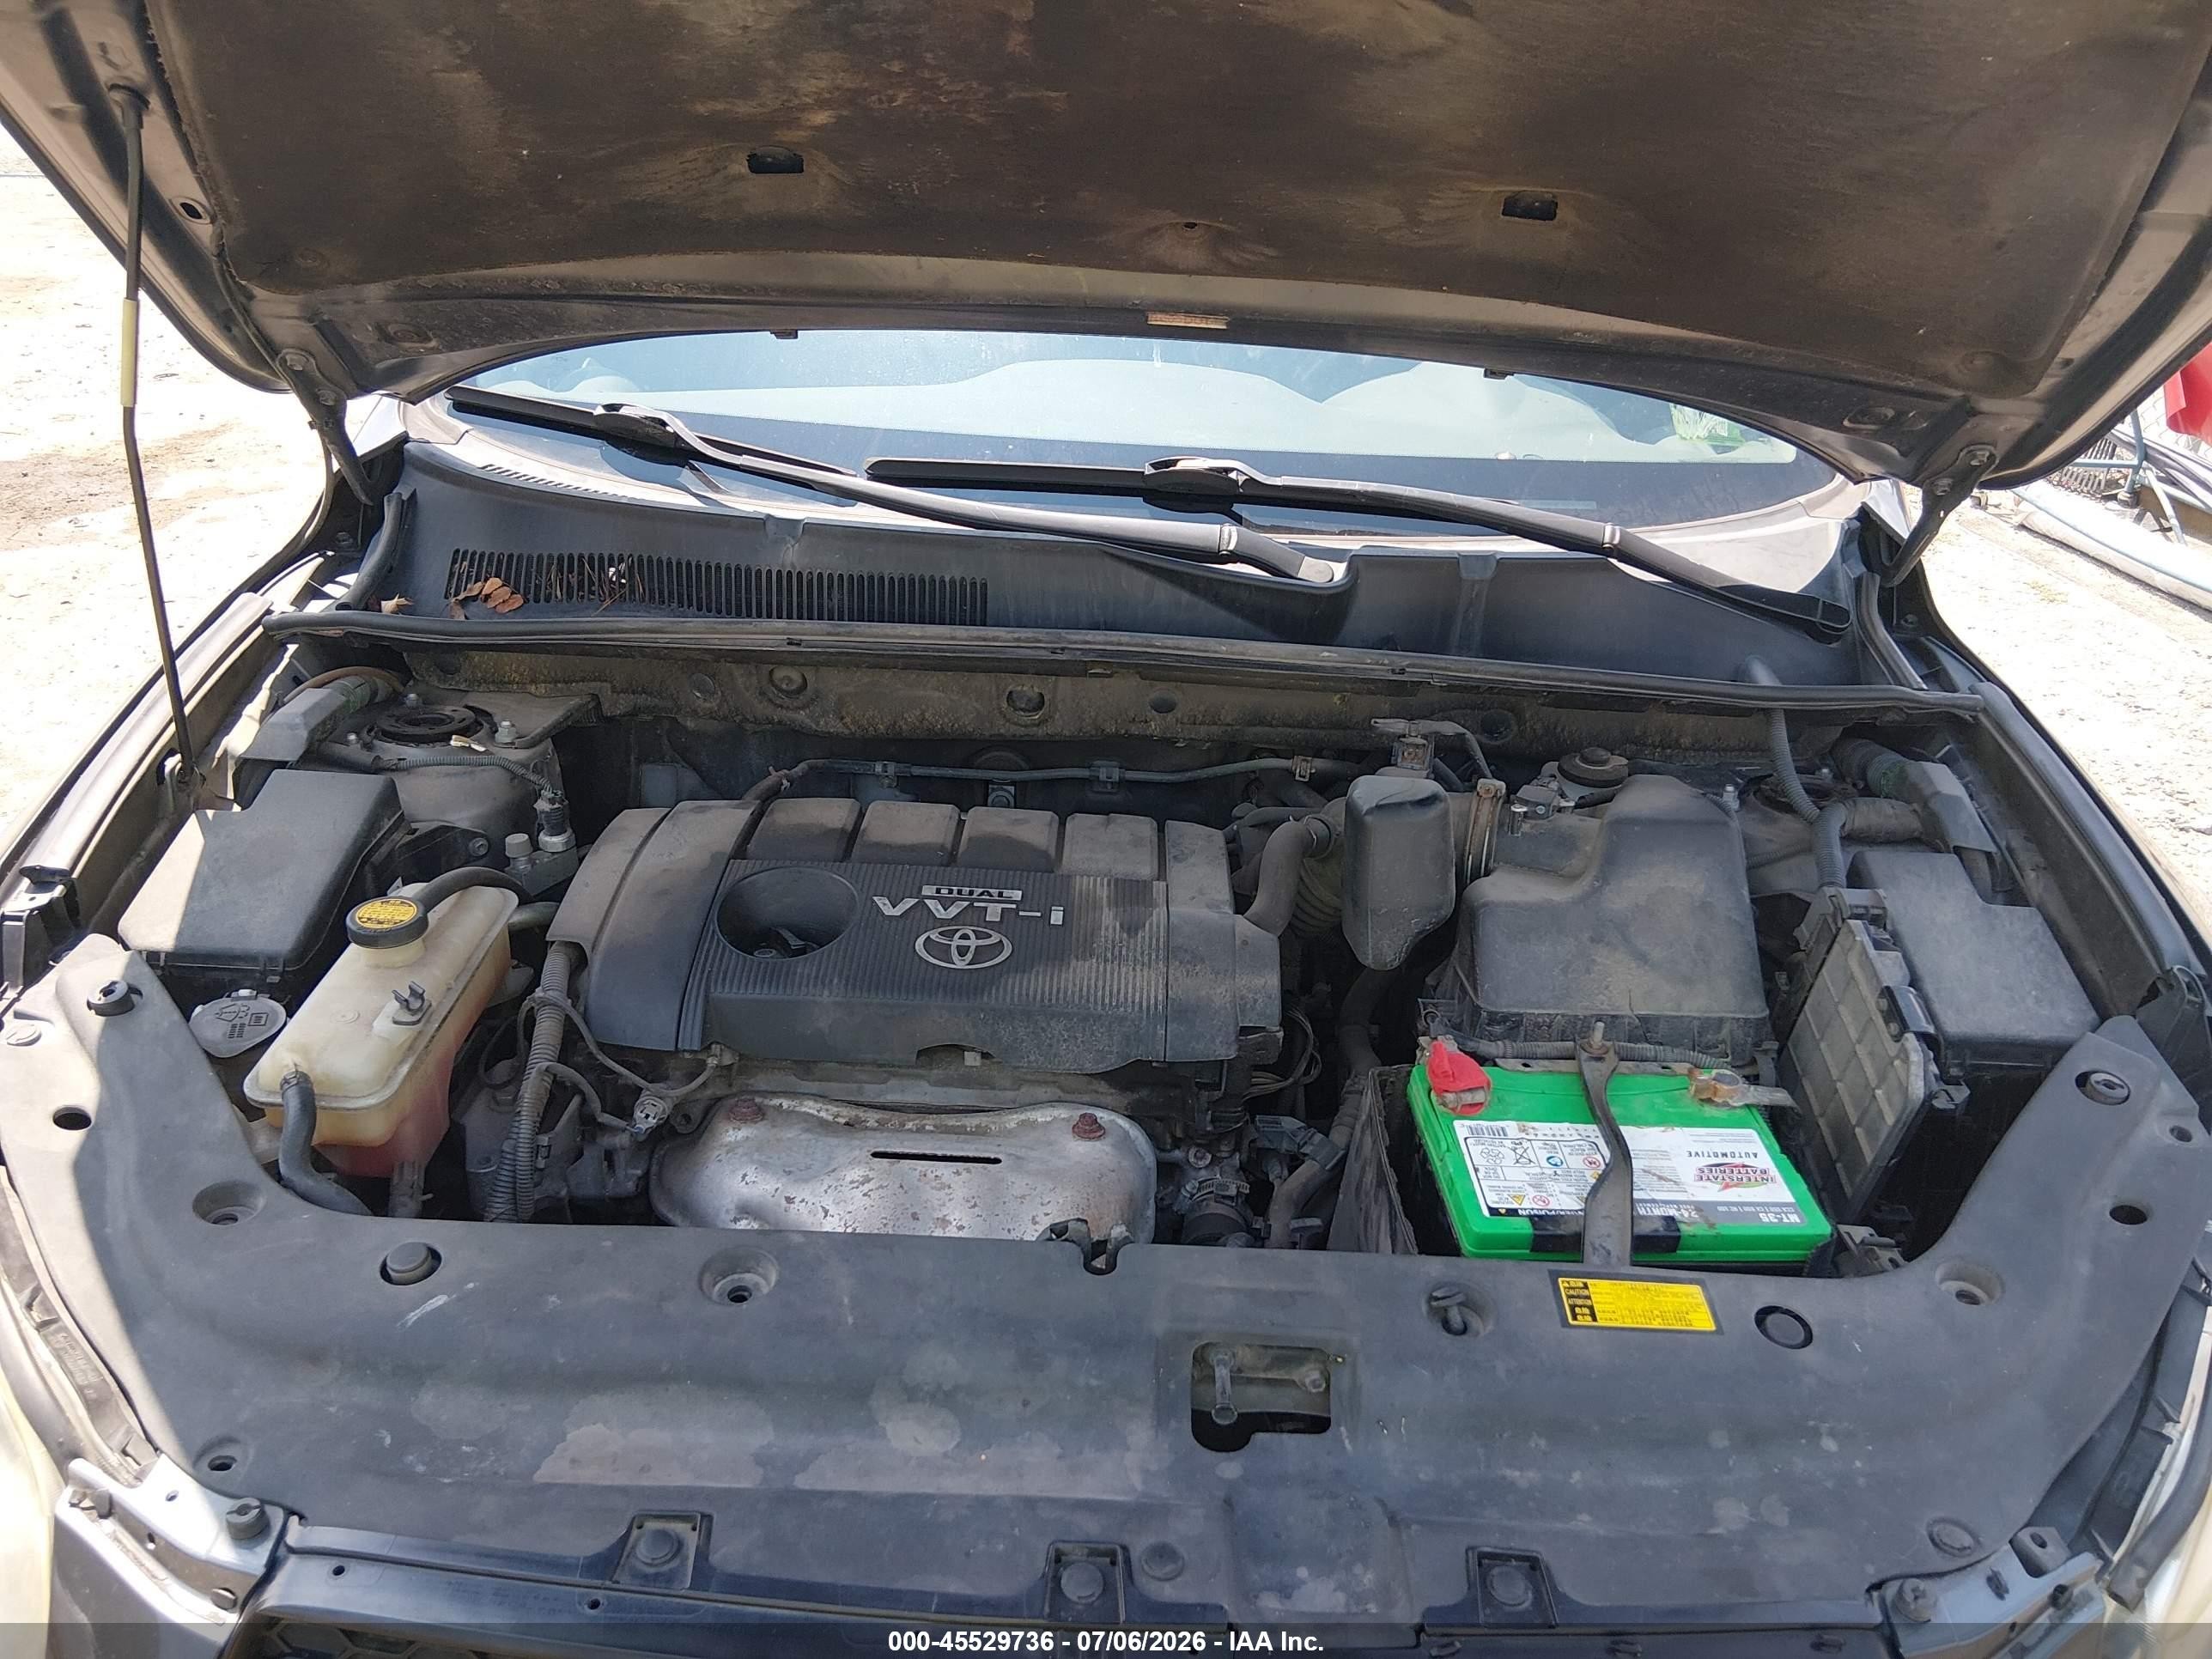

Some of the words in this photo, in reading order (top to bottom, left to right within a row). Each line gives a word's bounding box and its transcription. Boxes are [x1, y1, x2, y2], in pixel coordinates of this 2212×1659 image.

[935, 887, 1013, 898] DUAL
[872, 896, 1064, 926] VVT-i
[1686, 1151, 1759, 1159] AUTOMOTIVE
[1695, 1174, 1774, 1182] INTERSTATE
[1758, 1212, 1801, 1224] MT-35
